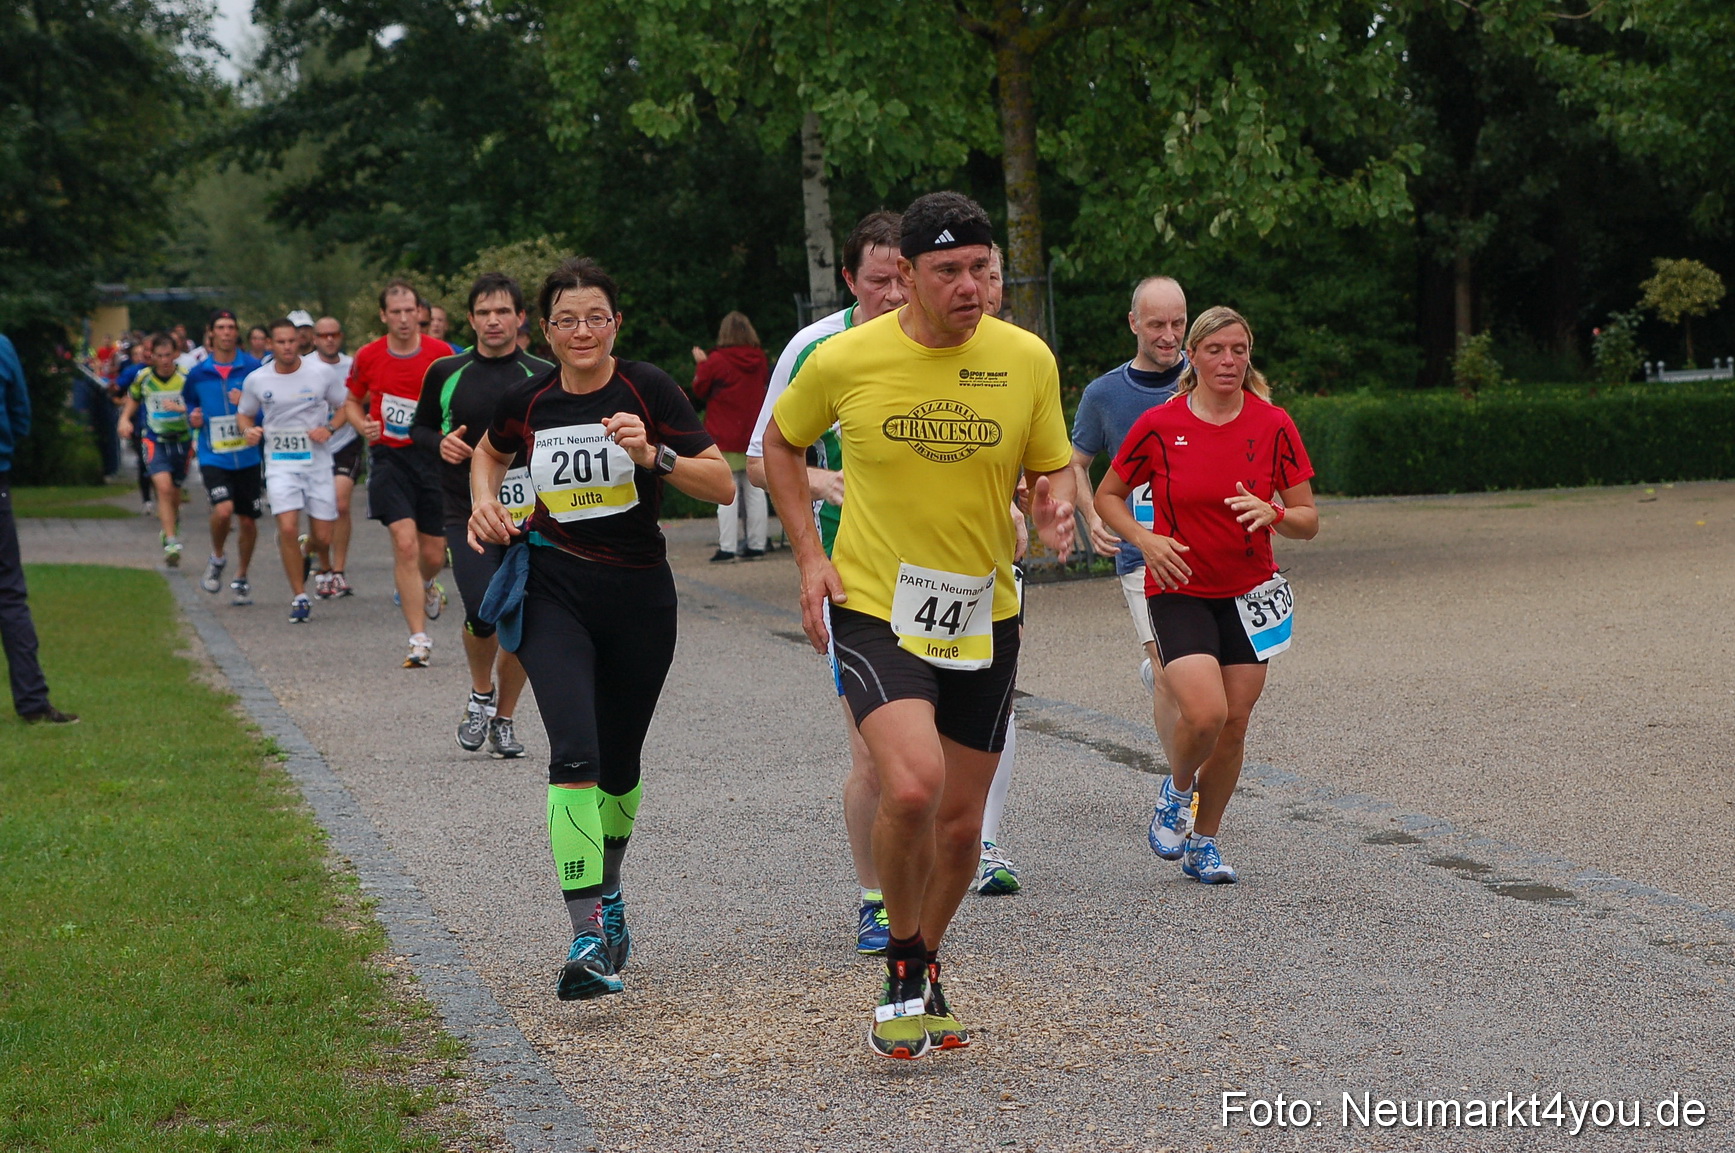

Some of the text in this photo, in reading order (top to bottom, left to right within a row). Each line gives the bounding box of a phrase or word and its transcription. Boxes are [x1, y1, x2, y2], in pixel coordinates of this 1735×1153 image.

[912, 402, 975, 421] PIZZERIA
[898, 419, 989, 442] FRANCESCO
[273, 435, 307, 450] 2491
[536, 437, 564, 449] PARTL
[914, 442, 976, 461] HERSBRUCK
[551, 447, 610, 486] 201
[570, 491, 604, 508] Jutta
[899, 574, 938, 591] PARTL
[914, 595, 981, 636] 447
[564, 873, 584, 881] cep
